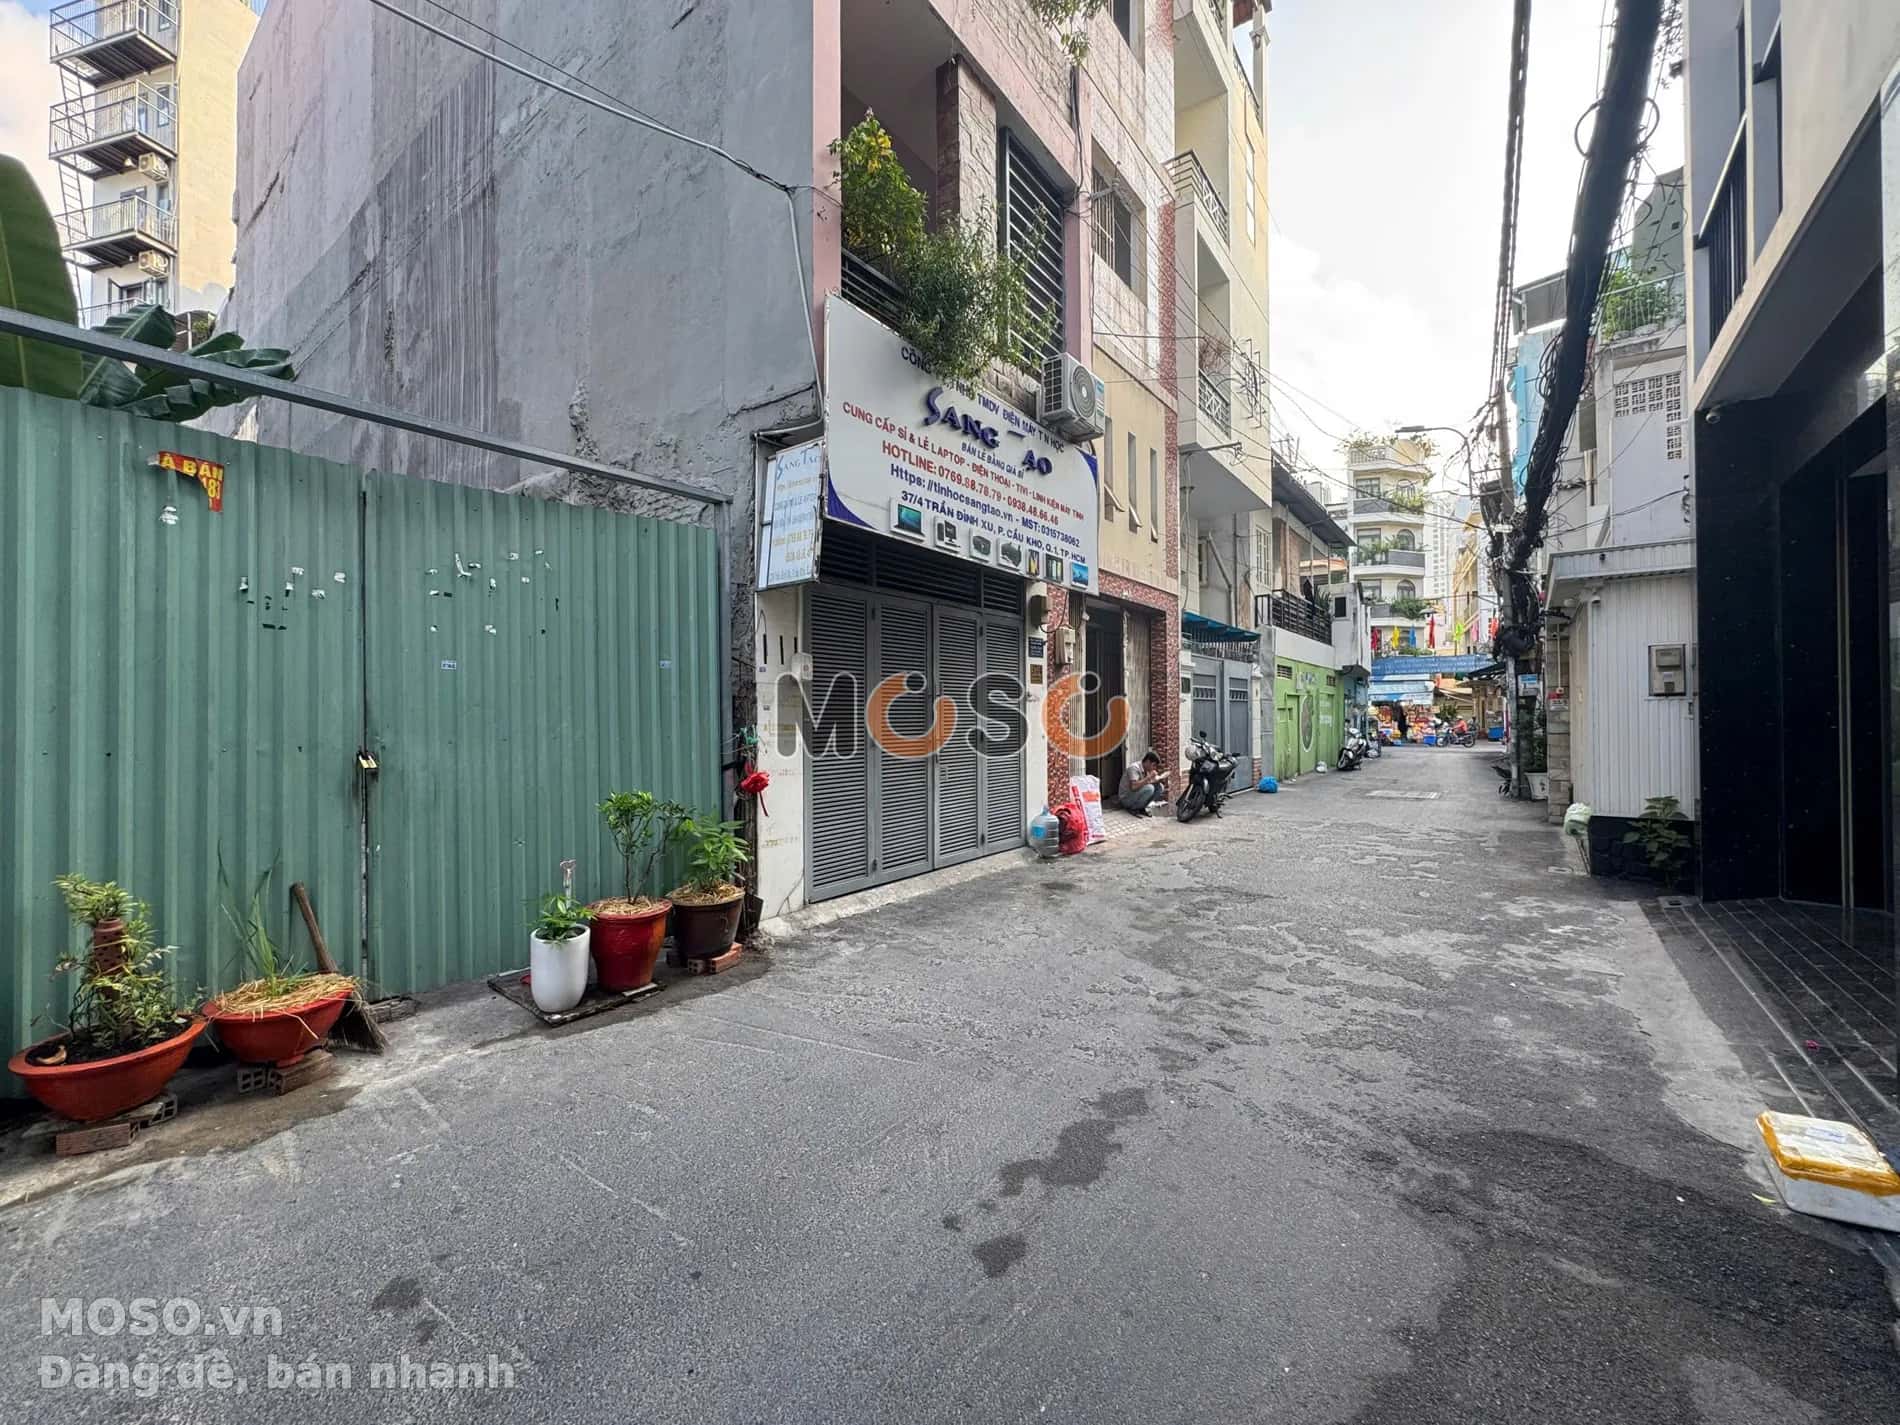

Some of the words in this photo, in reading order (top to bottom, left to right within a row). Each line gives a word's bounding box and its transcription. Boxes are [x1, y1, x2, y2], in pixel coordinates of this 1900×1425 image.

[842, 401, 873, 424] CUNG
[875, 416, 896, 433] CẤP
[931, 443, 966, 467] LAPTOP
[924, 386, 1000, 449] SANG
[882, 440, 937, 475] HOTLINE:
[901, 490, 924, 507] 37/4
